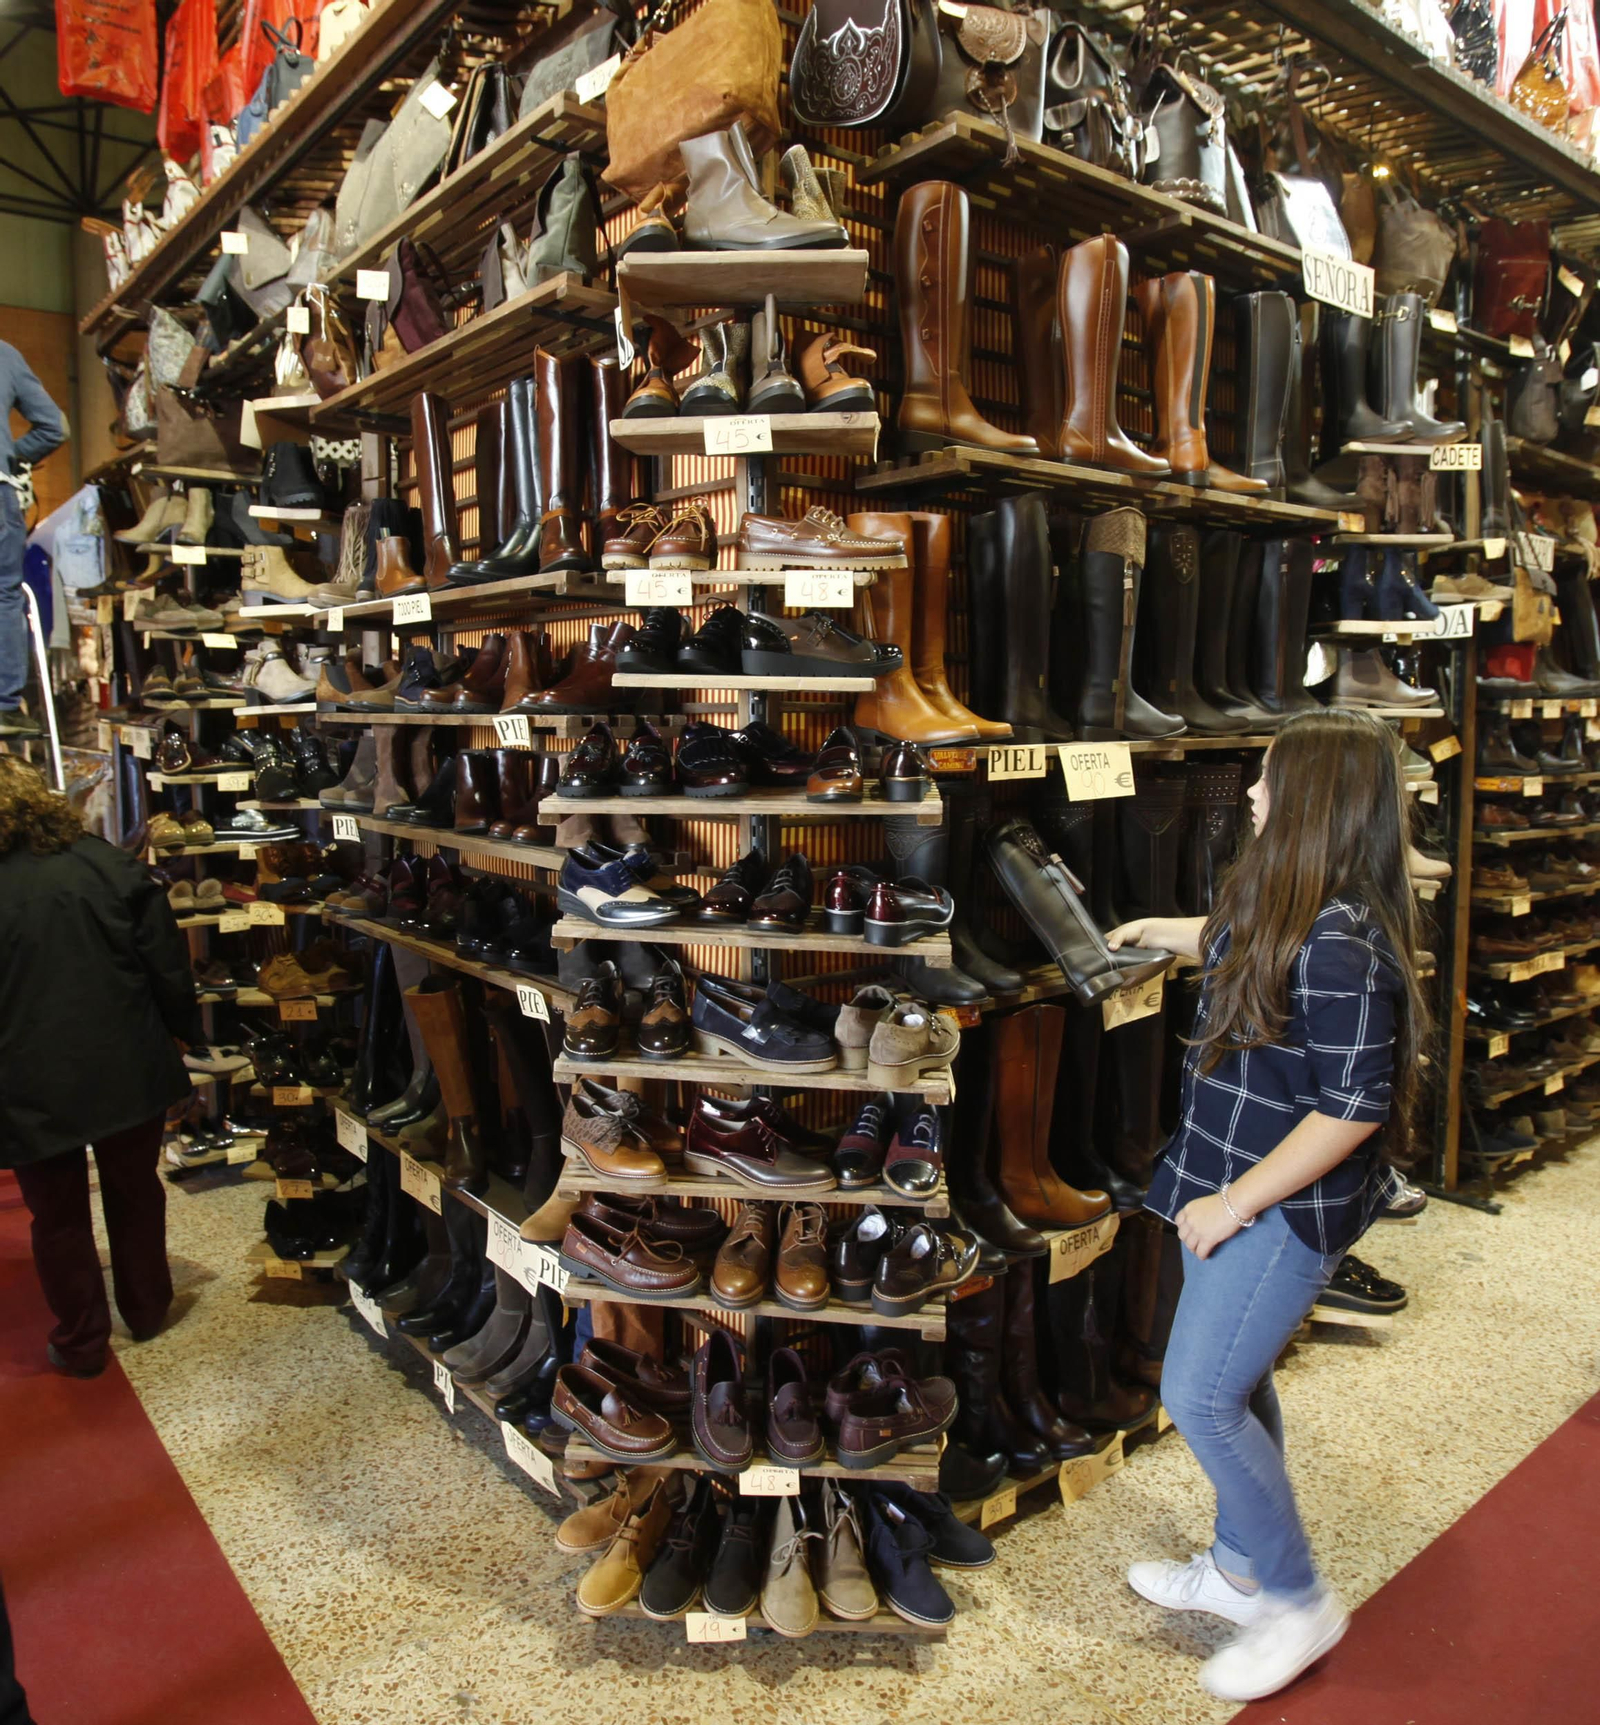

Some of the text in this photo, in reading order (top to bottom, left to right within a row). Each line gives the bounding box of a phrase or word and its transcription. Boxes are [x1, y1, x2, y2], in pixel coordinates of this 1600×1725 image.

[1304, 253, 1371, 313] SEÑORA
[730, 419, 765, 427] OFERTA
[716, 429, 749, 451] 45
[1432, 447, 1479, 466] CADETE
[638, 580, 668, 599] 45
[802, 582, 829, 602] 48
[990, 748, 1043, 773] PIEL
[1070, 752, 1110, 771] OFERTA
[1113, 772, 1132, 789] €
[493, 1220, 523, 1256] OFERTA
[1060, 1226, 1100, 1255] OFERTA
[751, 1474, 776, 1492] 48
[698, 1620, 720, 1641] 19
